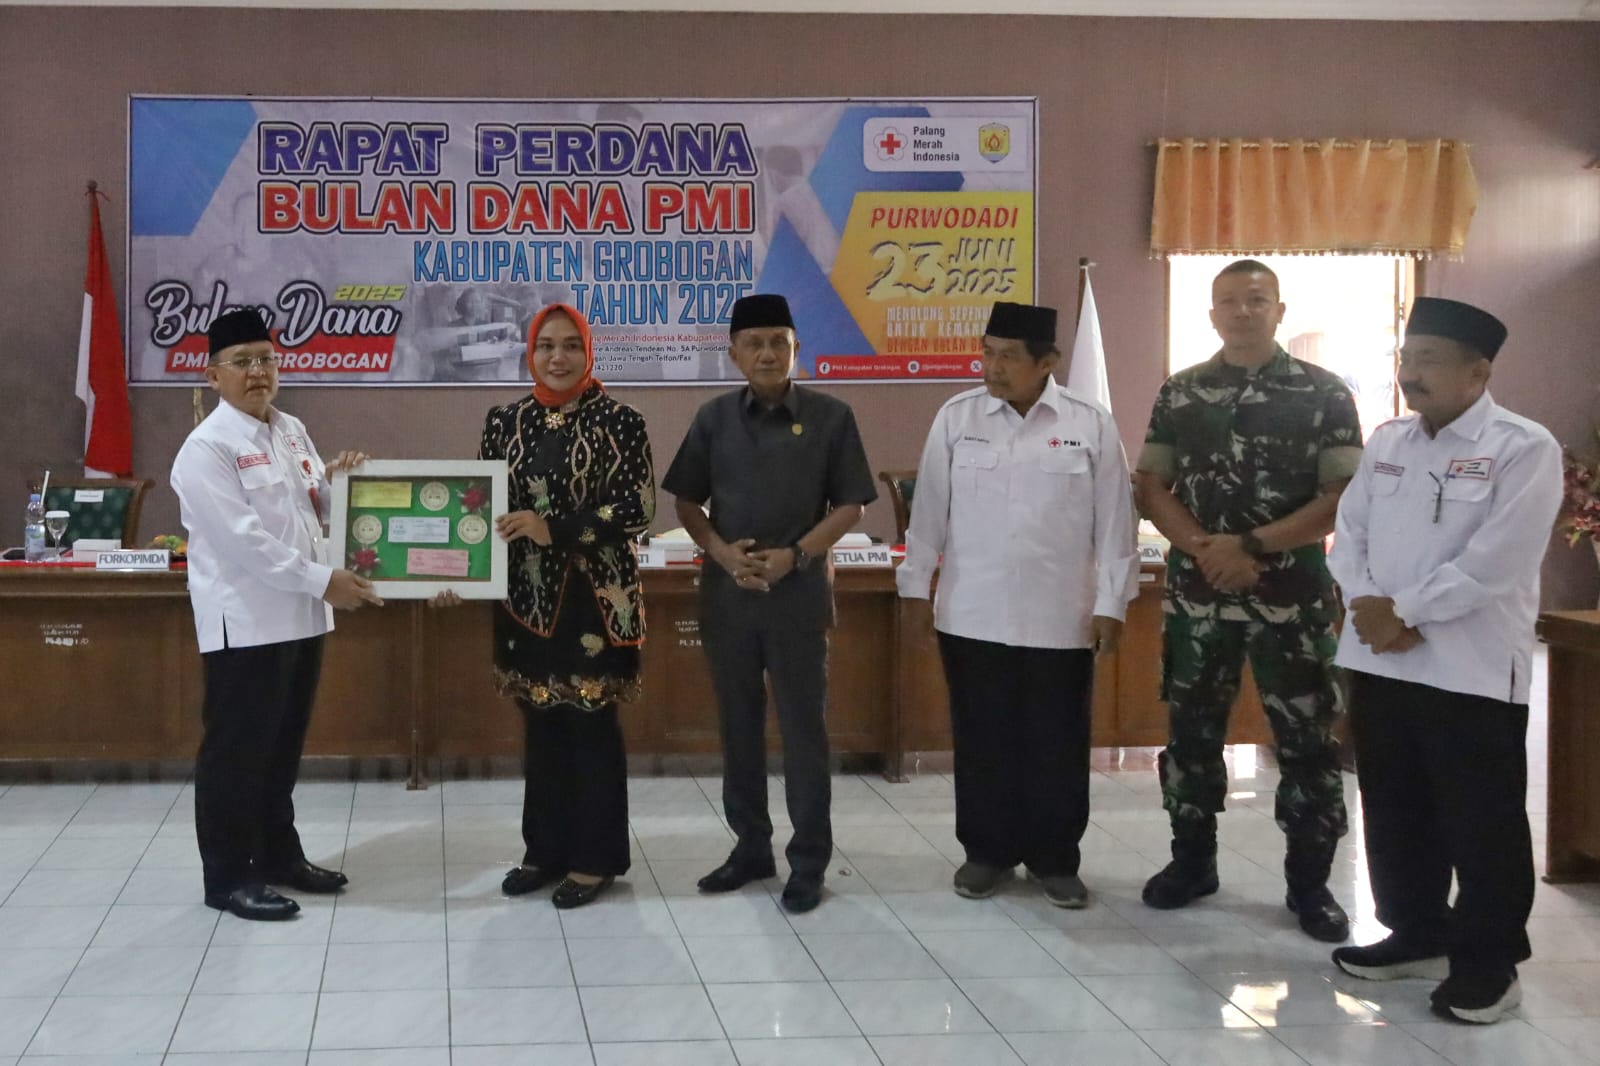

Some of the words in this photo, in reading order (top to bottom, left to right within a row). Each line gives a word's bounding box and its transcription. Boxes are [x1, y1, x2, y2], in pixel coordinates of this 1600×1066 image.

[913, 126, 945, 137] Palang
[258, 121, 448, 175] RAPAT
[476, 122, 759, 177] PERDANA
[913, 139, 943, 150] Merah
[913, 151, 960, 162] Indonesia
[258, 180, 456, 234] BULAN
[468, 181, 634, 235] DANA
[643, 181, 755, 235] PMI
[871, 207, 1018, 228] PURWODADI
[413, 240, 583, 282] KABUPATEN
[593, 240, 753, 282] GROBOGAN
[867, 240, 946, 300] 23
[334, 285, 407, 301] 2025
[571, 284, 669, 325] TAHUN
[277, 280, 401, 348] Dana
[633, 334, 675, 342] Indonesia
[677, 334, 724, 344] Kabupaten
[172, 353, 208, 368] PMI
[99, 553, 166, 565] FORKOPIMDA
[867, 551, 888, 562] PMI
